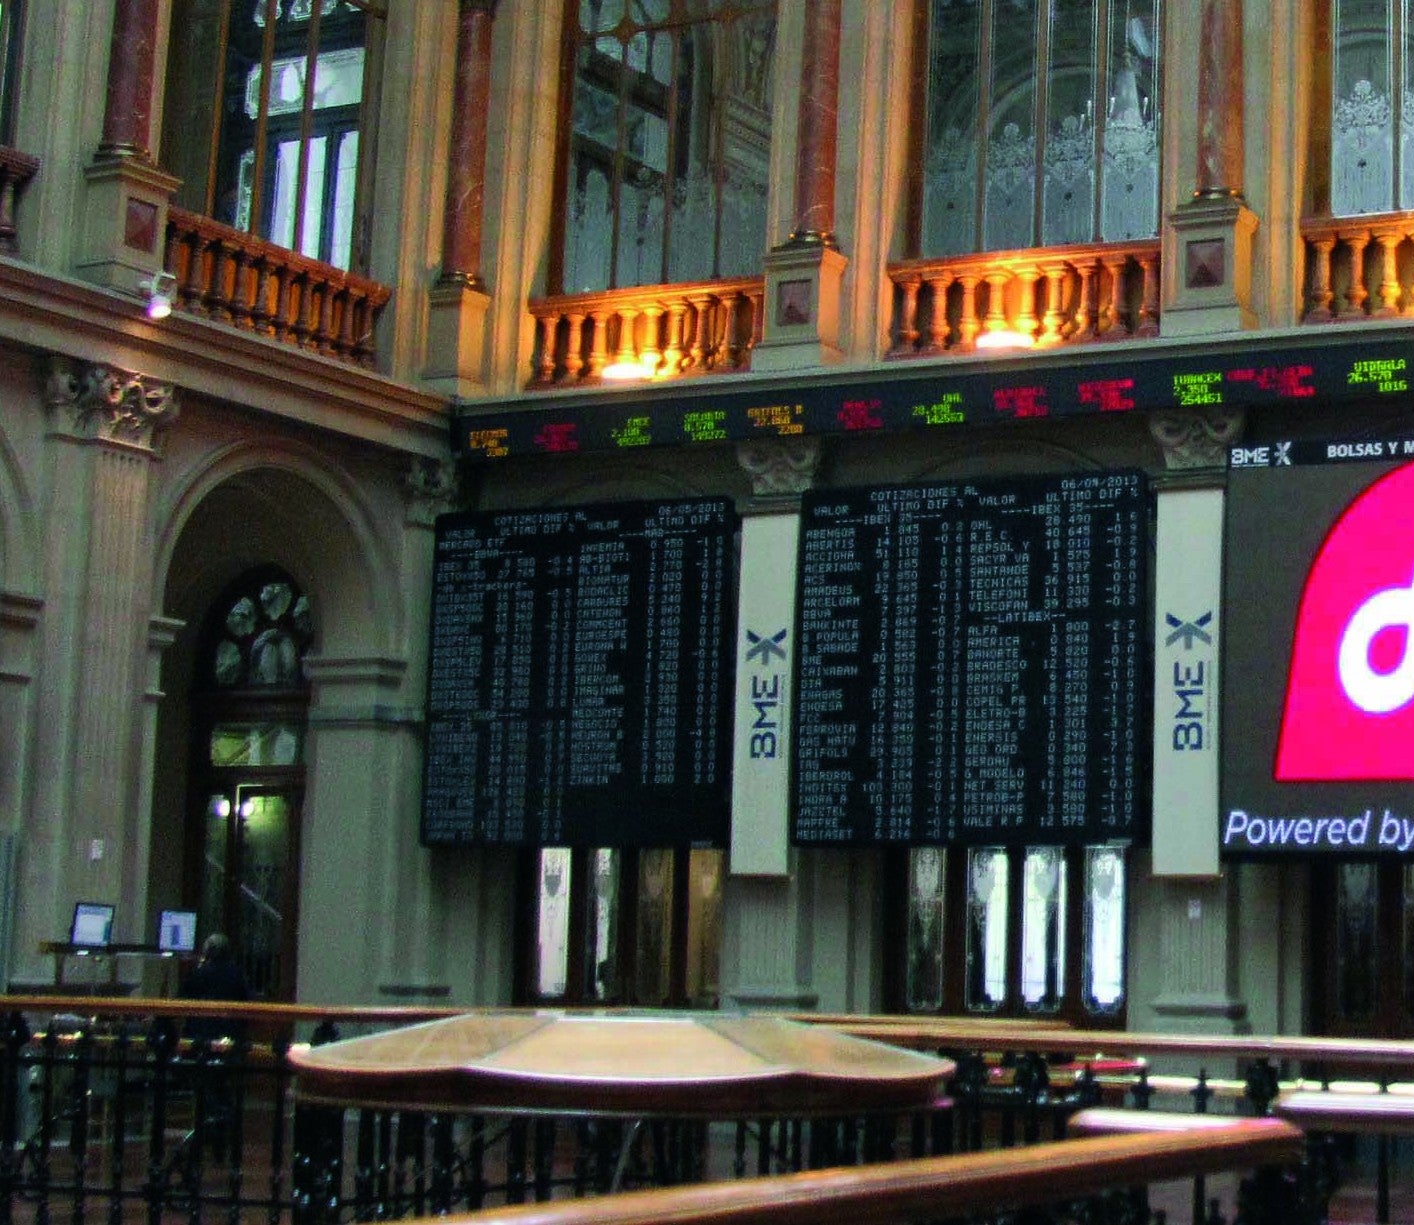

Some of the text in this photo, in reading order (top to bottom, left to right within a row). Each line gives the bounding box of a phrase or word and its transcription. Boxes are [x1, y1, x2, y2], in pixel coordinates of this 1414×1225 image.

[1231, 448, 1269, 464] BME
[1327, 442, 1382, 458] BOLSAS
[1388, 441, 1398, 453] Y
[750, 674, 778, 759] BME
[1173, 661, 1204, 751] BME
[1225, 811, 1369, 845] Powered
